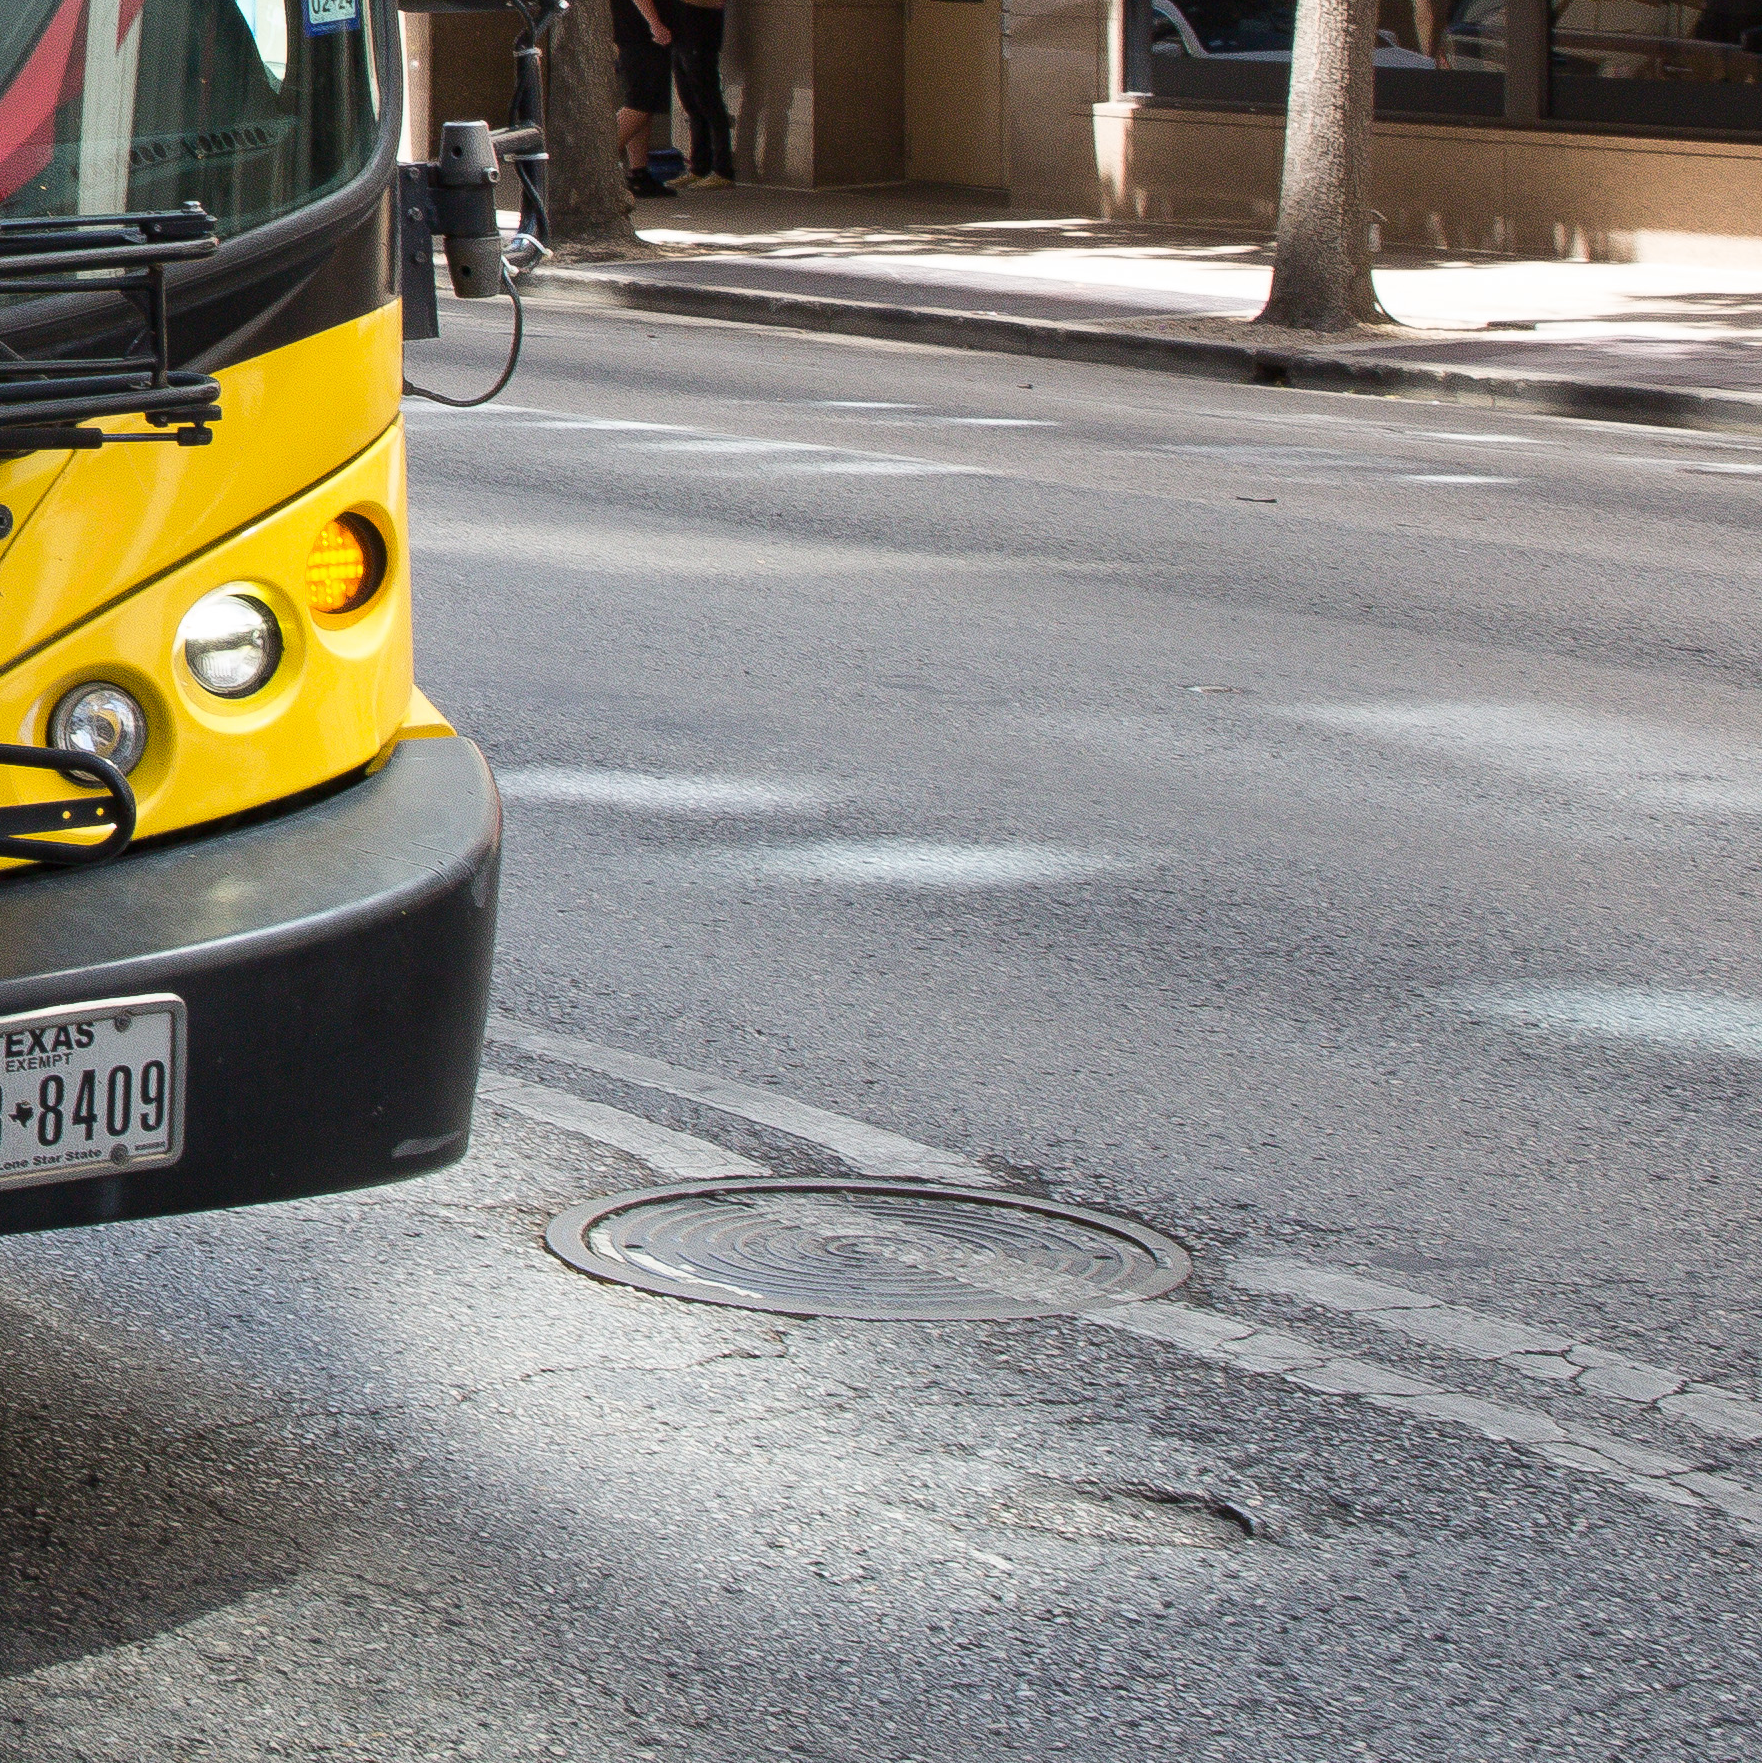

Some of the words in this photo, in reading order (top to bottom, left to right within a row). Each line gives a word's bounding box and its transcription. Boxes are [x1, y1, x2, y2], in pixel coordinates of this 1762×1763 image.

[5, 1050, 73, 1075] EXEMPT
[31, 1153, 62, 1168] Star
[64, 1147, 103, 1164] State
